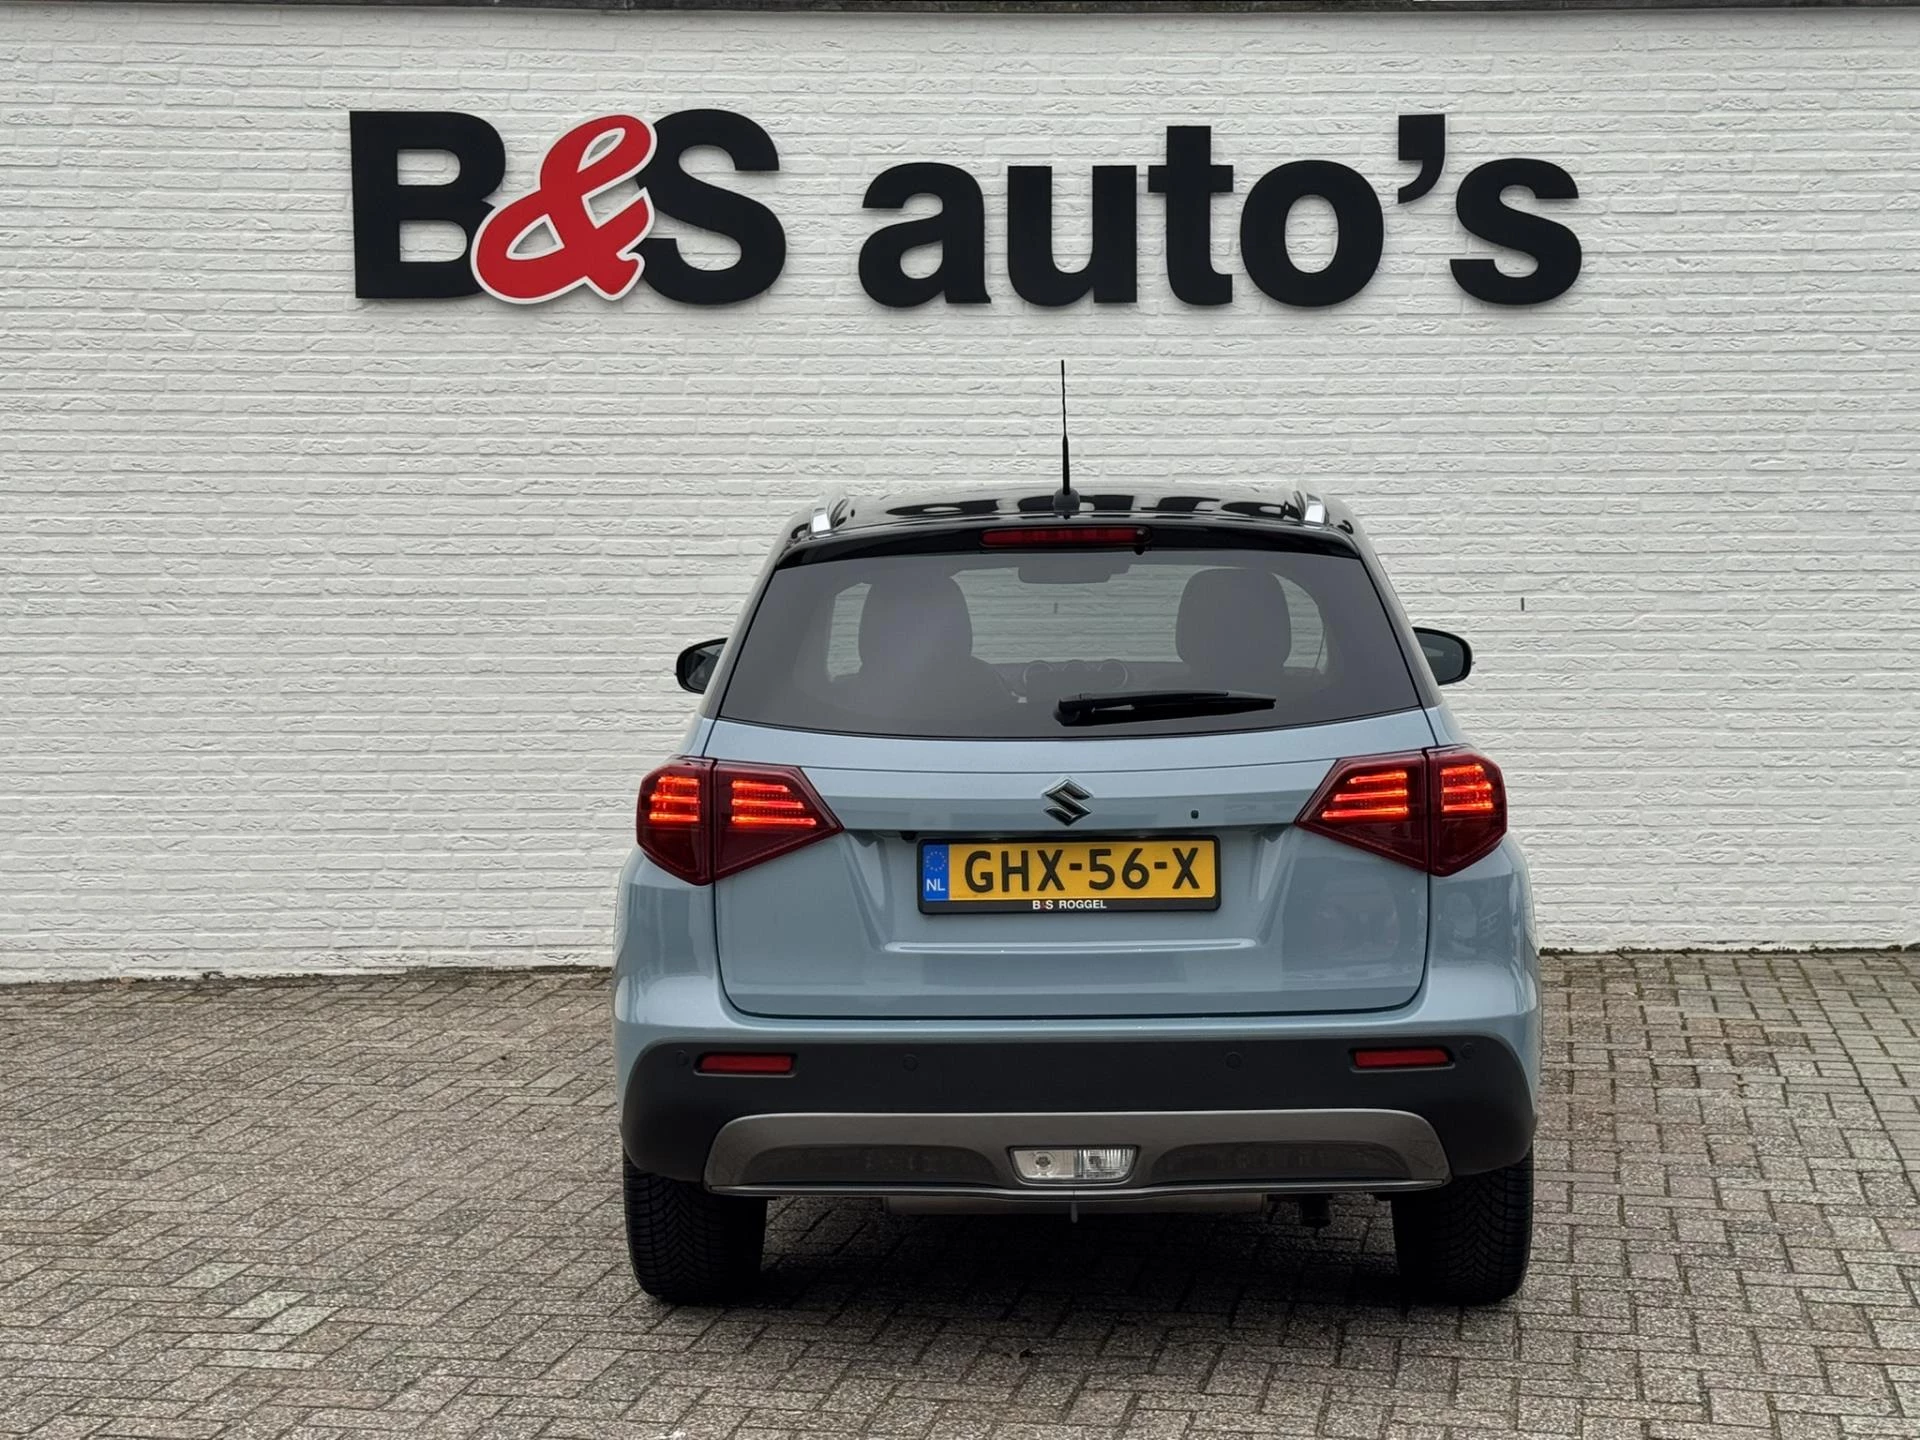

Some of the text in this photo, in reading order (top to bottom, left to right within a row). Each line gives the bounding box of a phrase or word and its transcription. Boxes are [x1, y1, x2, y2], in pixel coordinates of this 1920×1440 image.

[349, 108, 1582, 308] B&S auto's
[926, 878, 945, 891] NL
[964, 847, 1200, 893] GHX-56-X
[1059, 899, 1107, 909] ROGGEL
